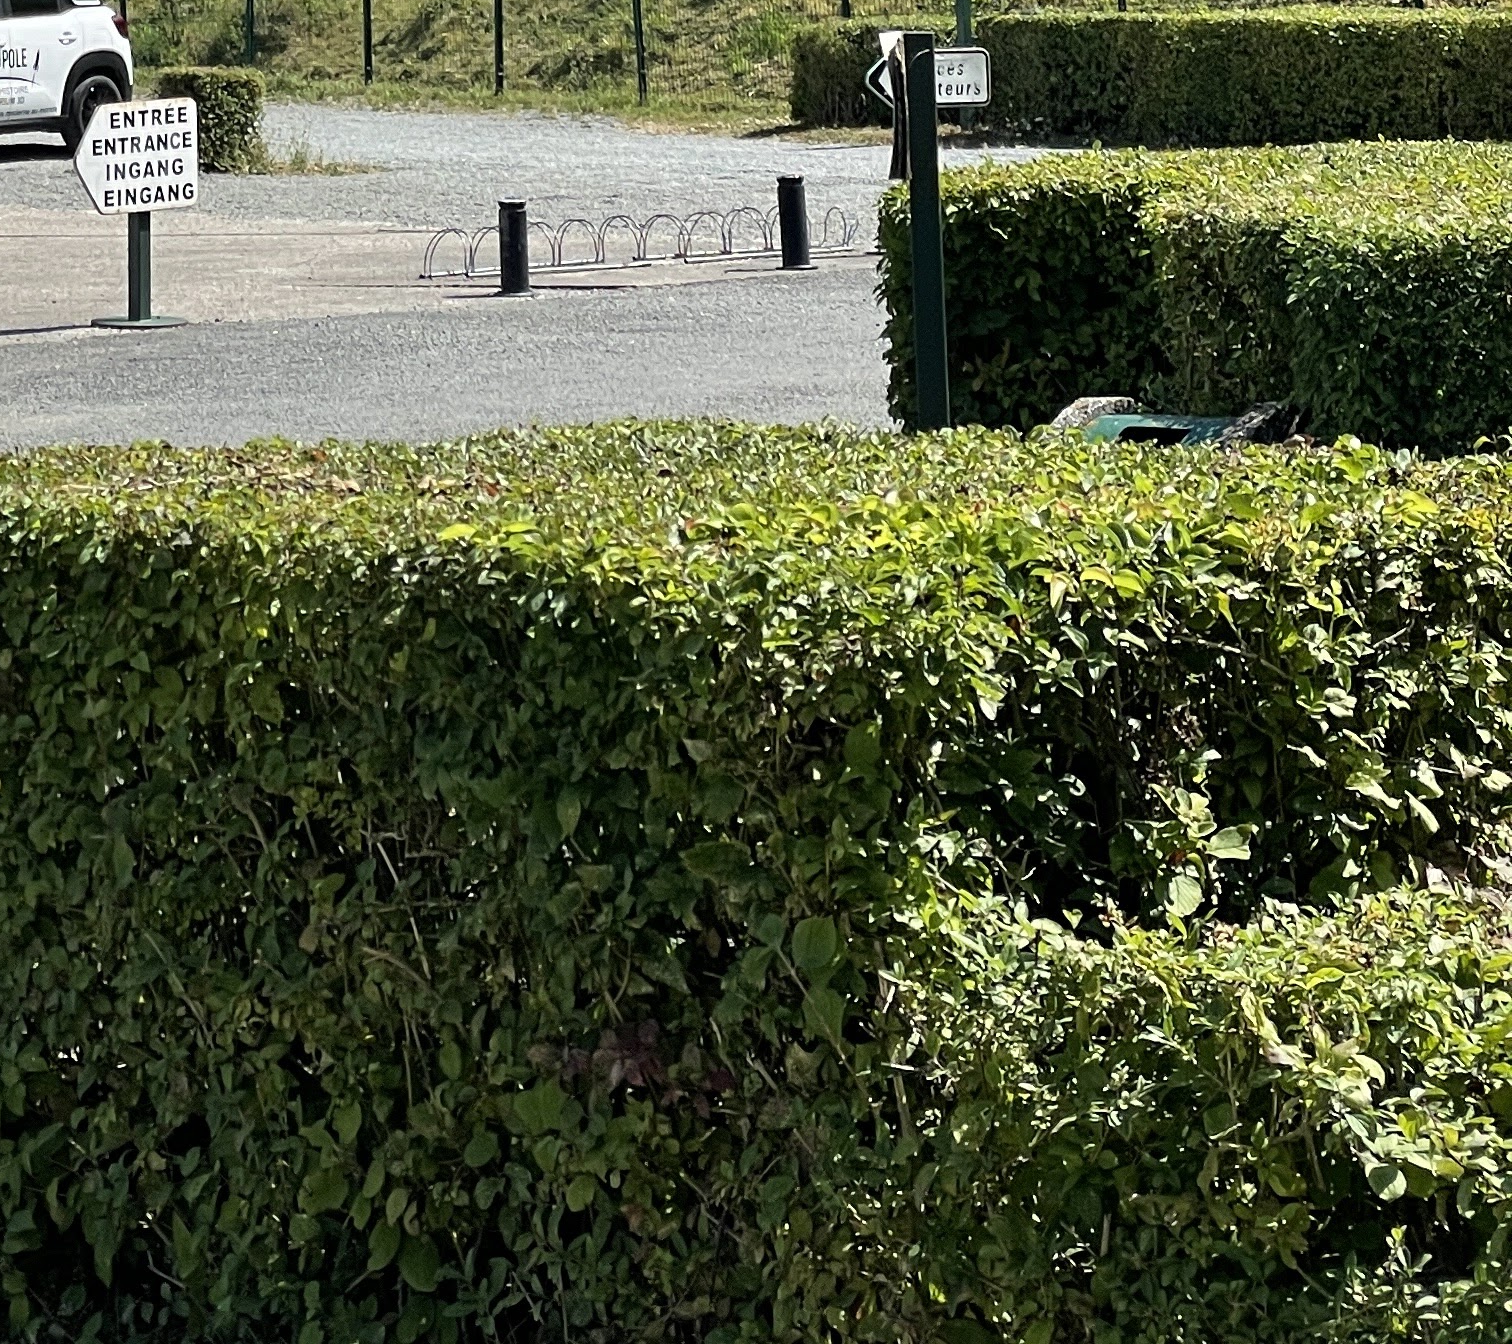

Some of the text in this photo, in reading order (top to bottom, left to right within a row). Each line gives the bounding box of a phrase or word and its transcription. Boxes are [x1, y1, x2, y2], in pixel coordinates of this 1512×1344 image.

[936, 61, 964, 76] cès
[937, 81, 981, 97] teurs
[110, 103, 188, 130] ENTRÉE
[92, 131, 193, 157] ENTRANCE
[106, 158, 184, 182] INGANG
[104, 183, 194, 208] EINGANG
